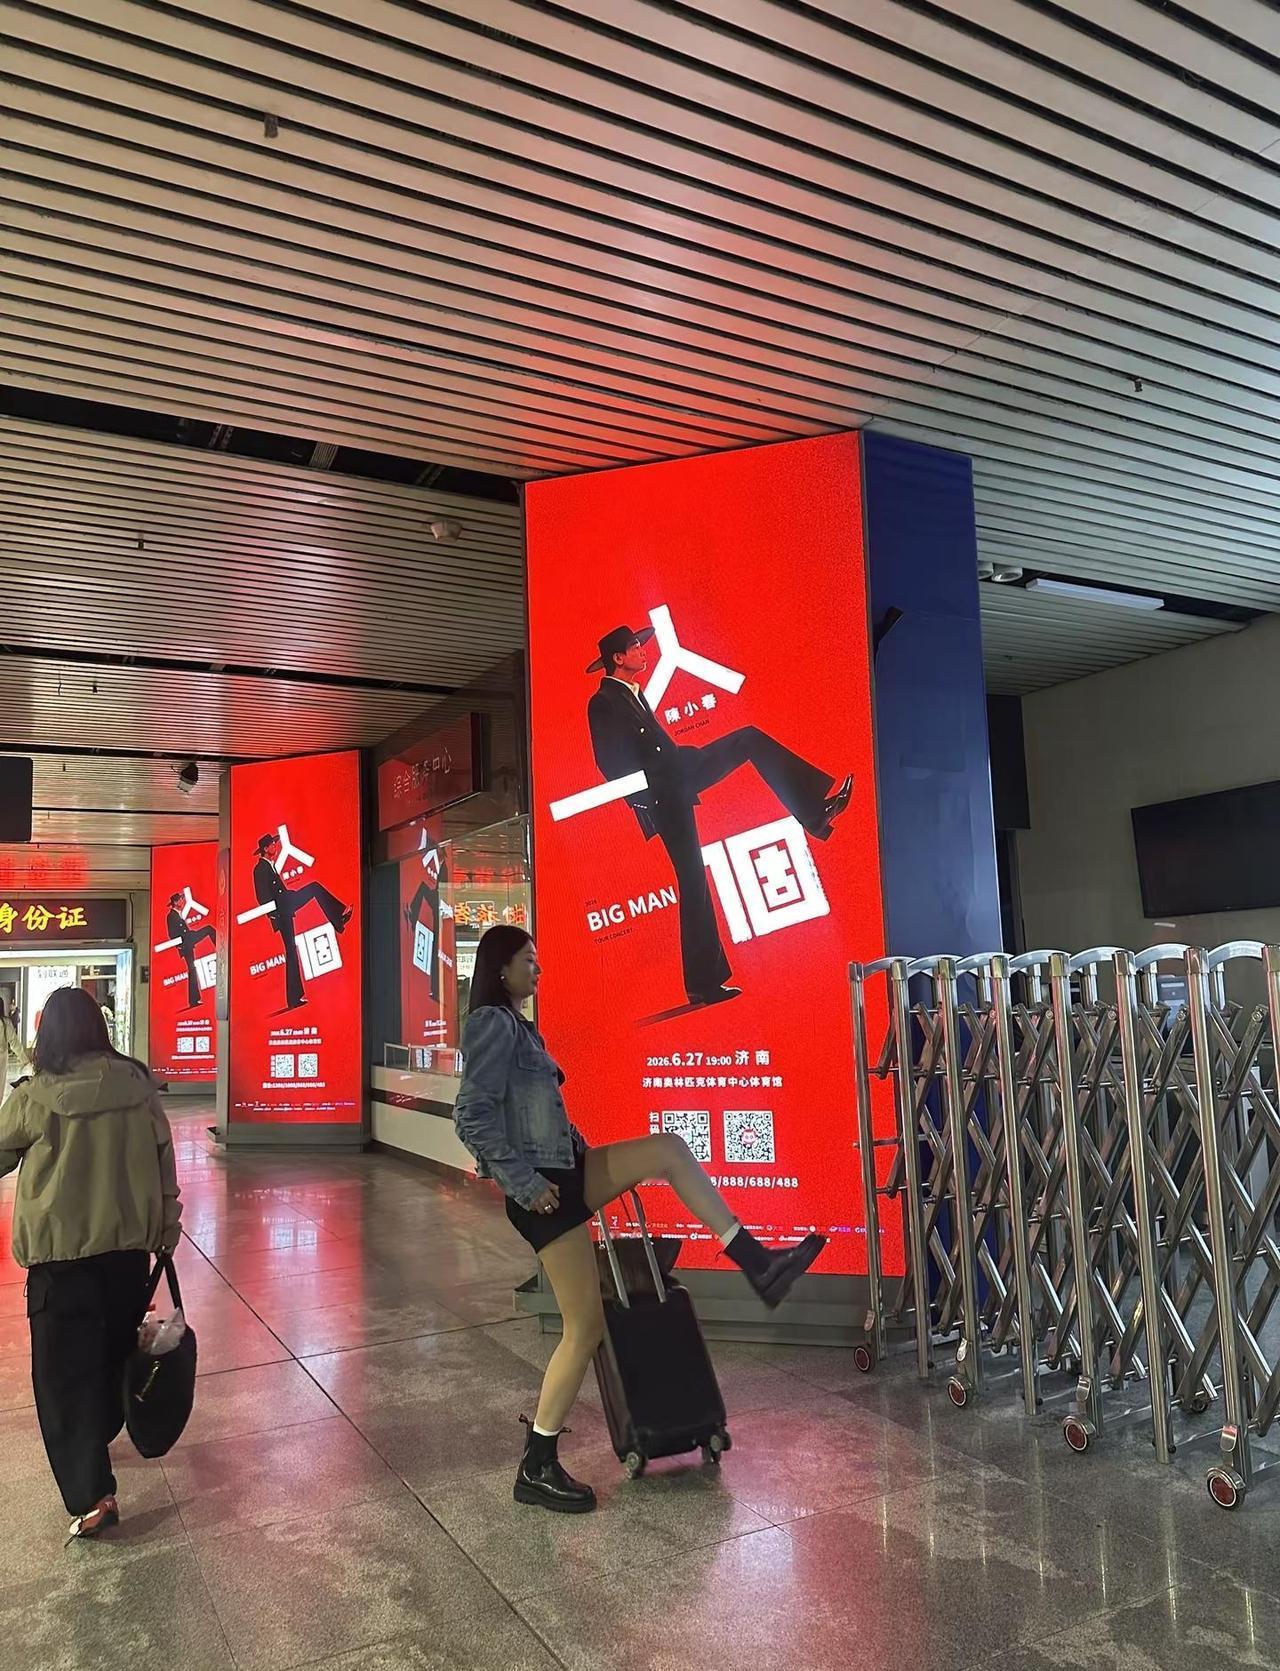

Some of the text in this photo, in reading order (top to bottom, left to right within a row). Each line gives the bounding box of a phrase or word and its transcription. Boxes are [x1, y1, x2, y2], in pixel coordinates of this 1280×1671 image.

[664, 693, 717, 725] 陳小春
[695, 719, 710, 729] CHAN
[0, 902, 88, 934] 身份证
[587, 886, 677, 932] BIG MAN
[250, 953, 286, 976] BIG MAN
[646, 1050, 770, 1066] 2026.6.27 19:00 济南
[642, 1076, 783, 1088] 济南奥林匹克体育中心体育馆
